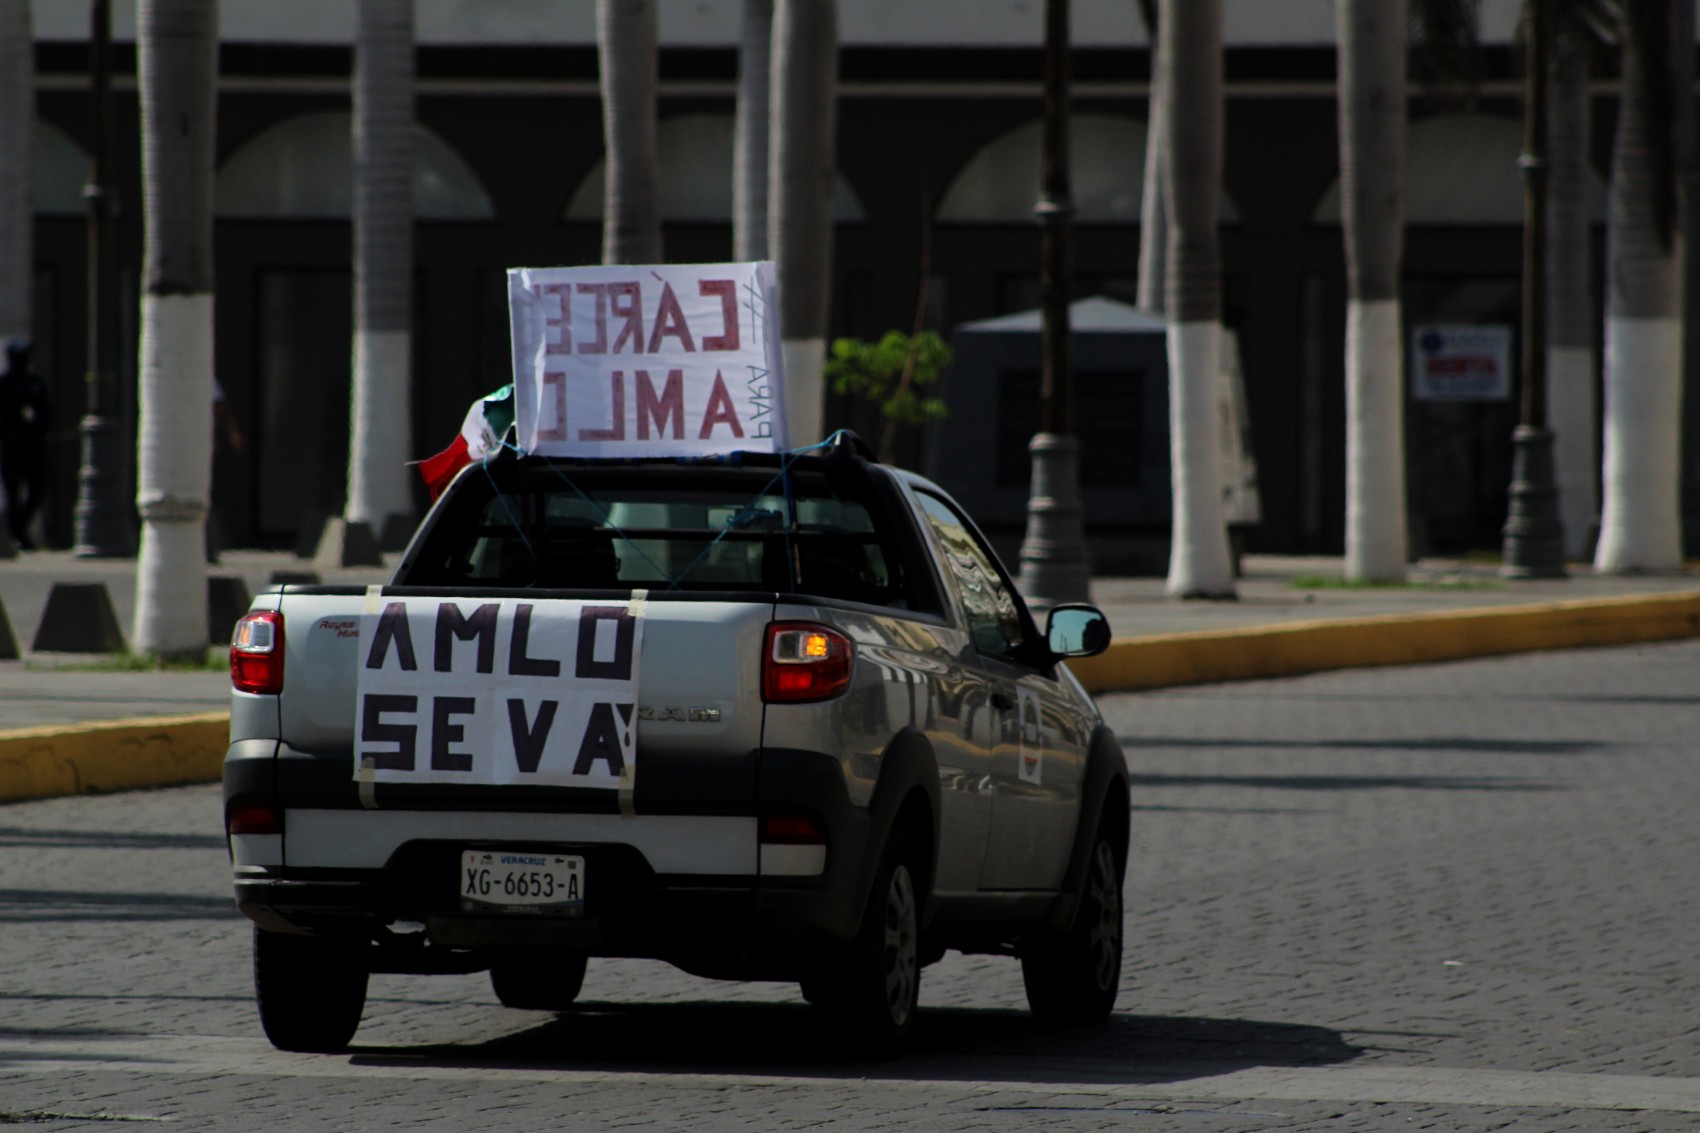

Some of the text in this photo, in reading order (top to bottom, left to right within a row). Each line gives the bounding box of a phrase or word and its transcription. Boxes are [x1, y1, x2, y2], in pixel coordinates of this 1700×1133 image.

[366, 602, 636, 681] AMLO
[637, 704, 722, 723] RAM
[500, 855, 547, 867] VERACRUZ
[465, 867, 580, 900] XG-6653-A
